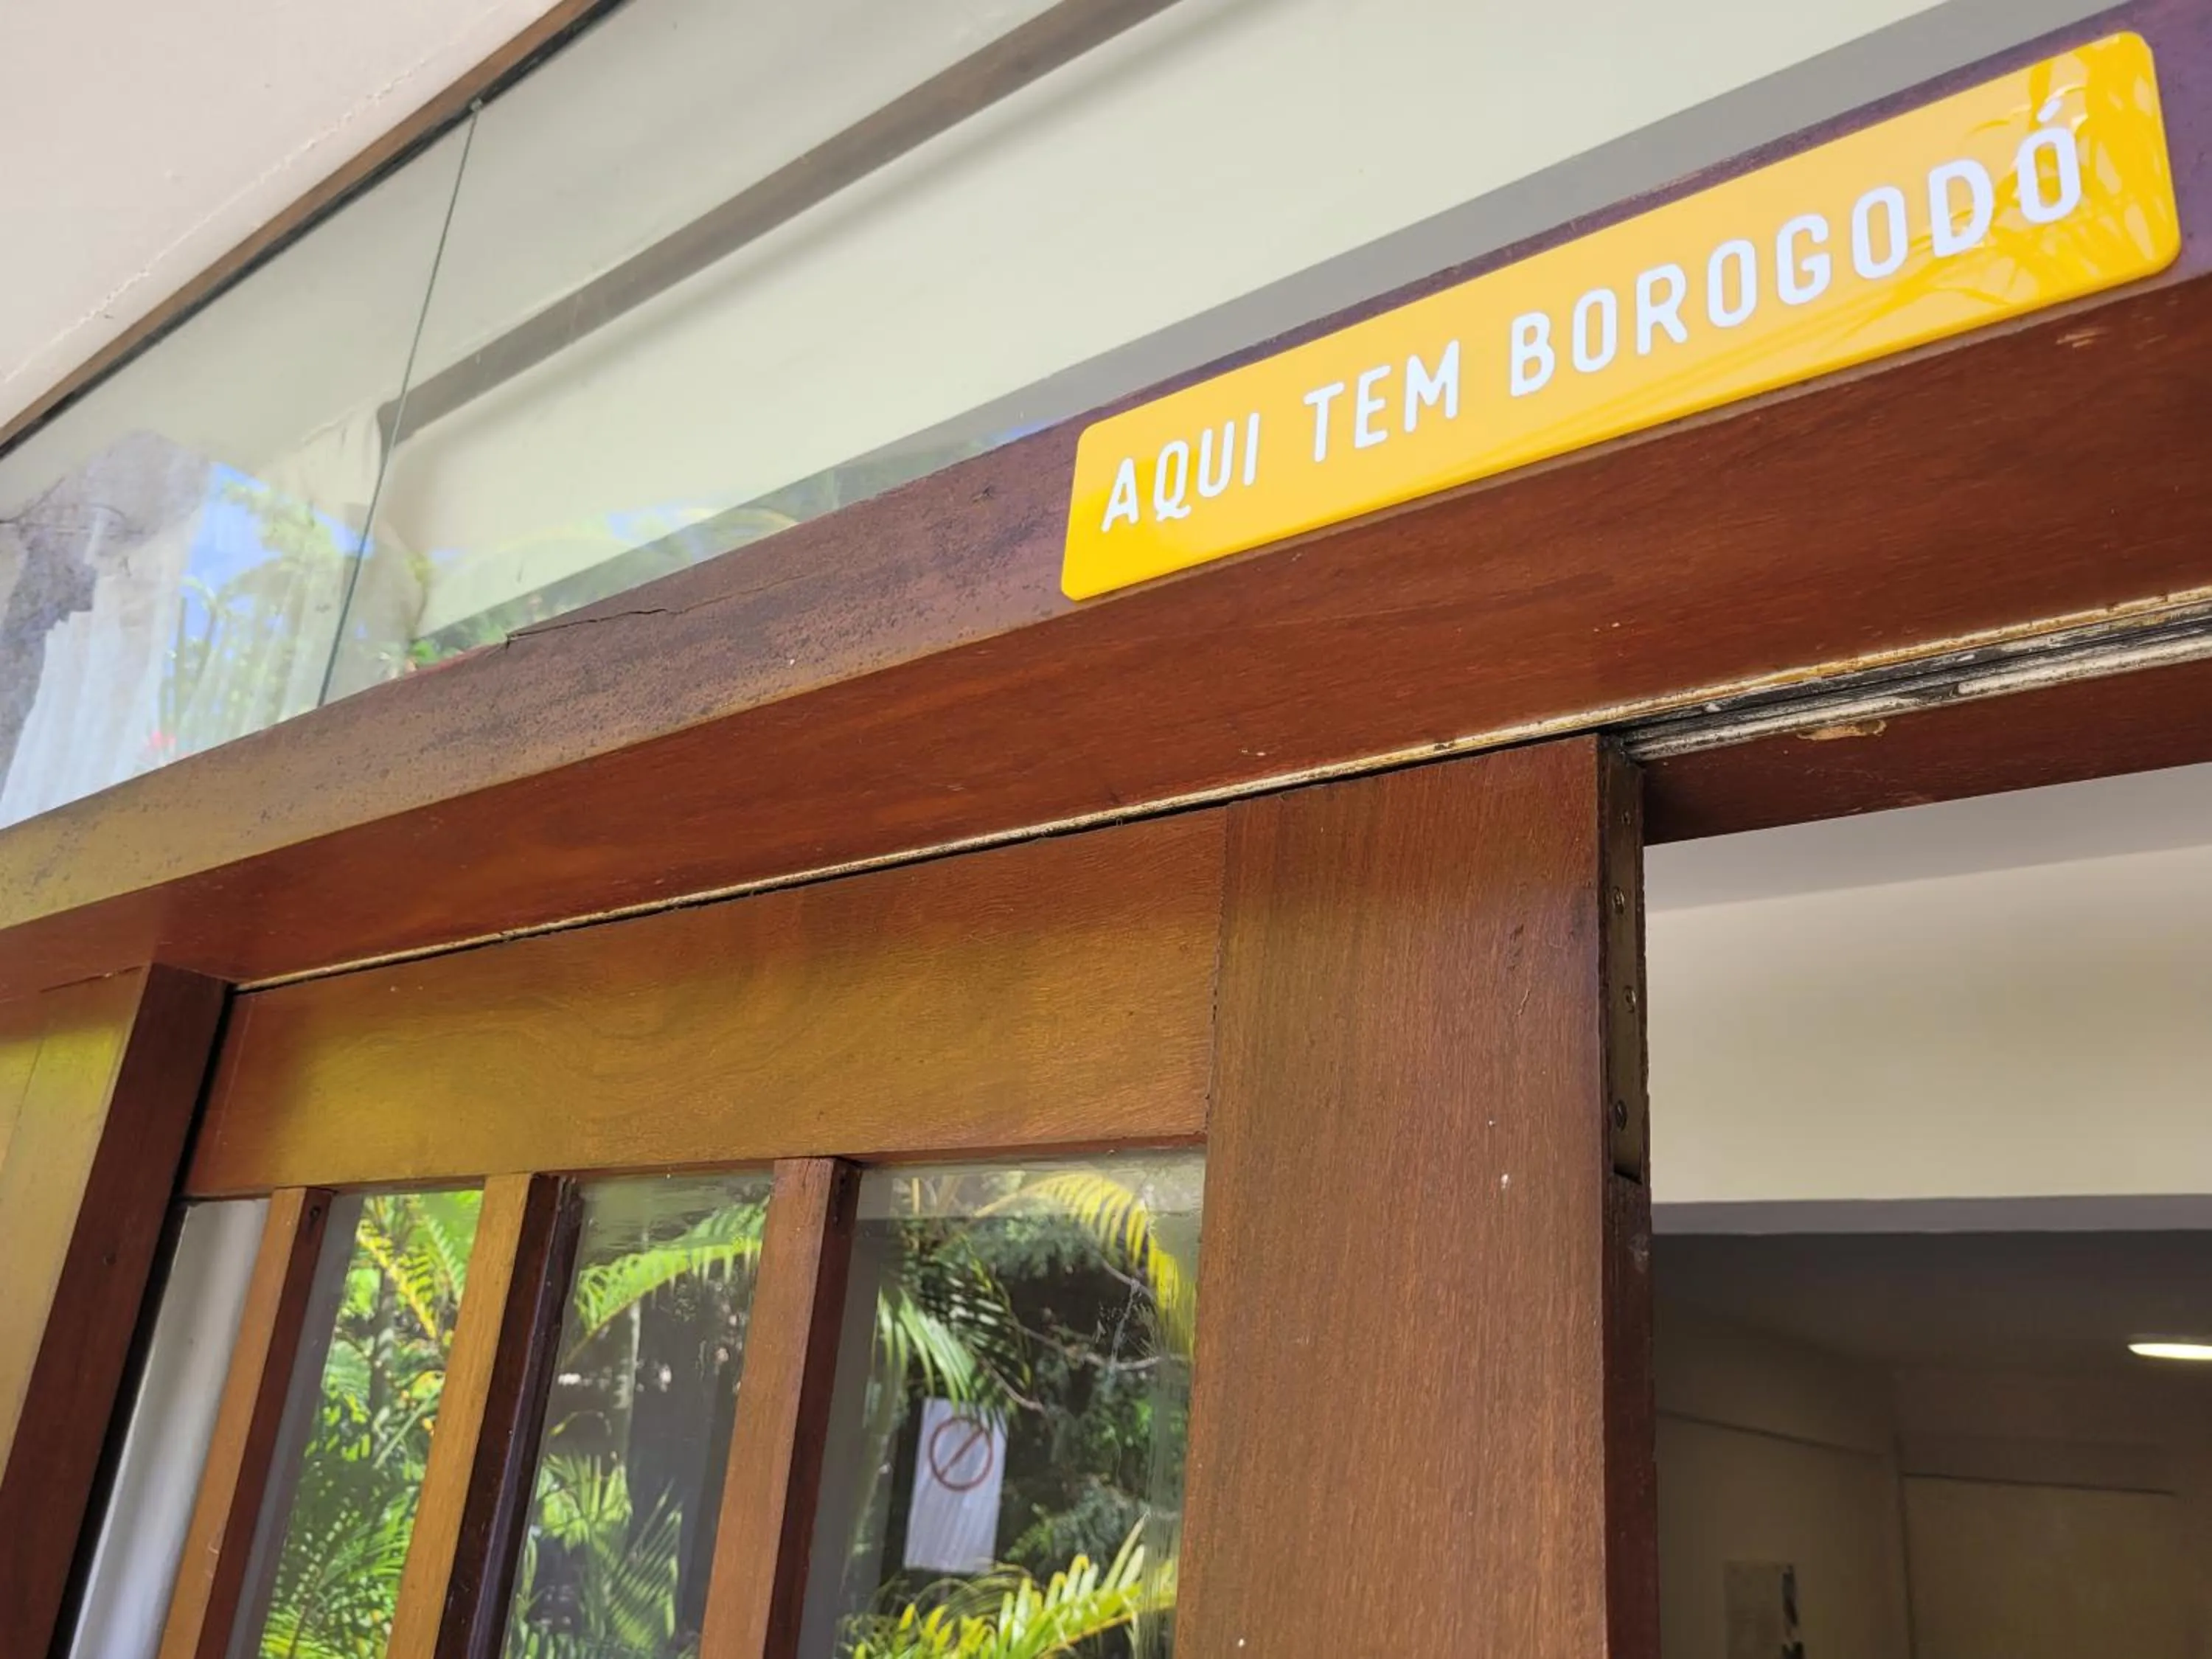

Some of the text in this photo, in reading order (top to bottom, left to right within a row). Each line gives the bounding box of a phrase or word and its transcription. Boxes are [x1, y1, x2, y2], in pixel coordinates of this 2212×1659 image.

[1102, 96, 2082, 532] AQUI TEM BOROGODÓ
